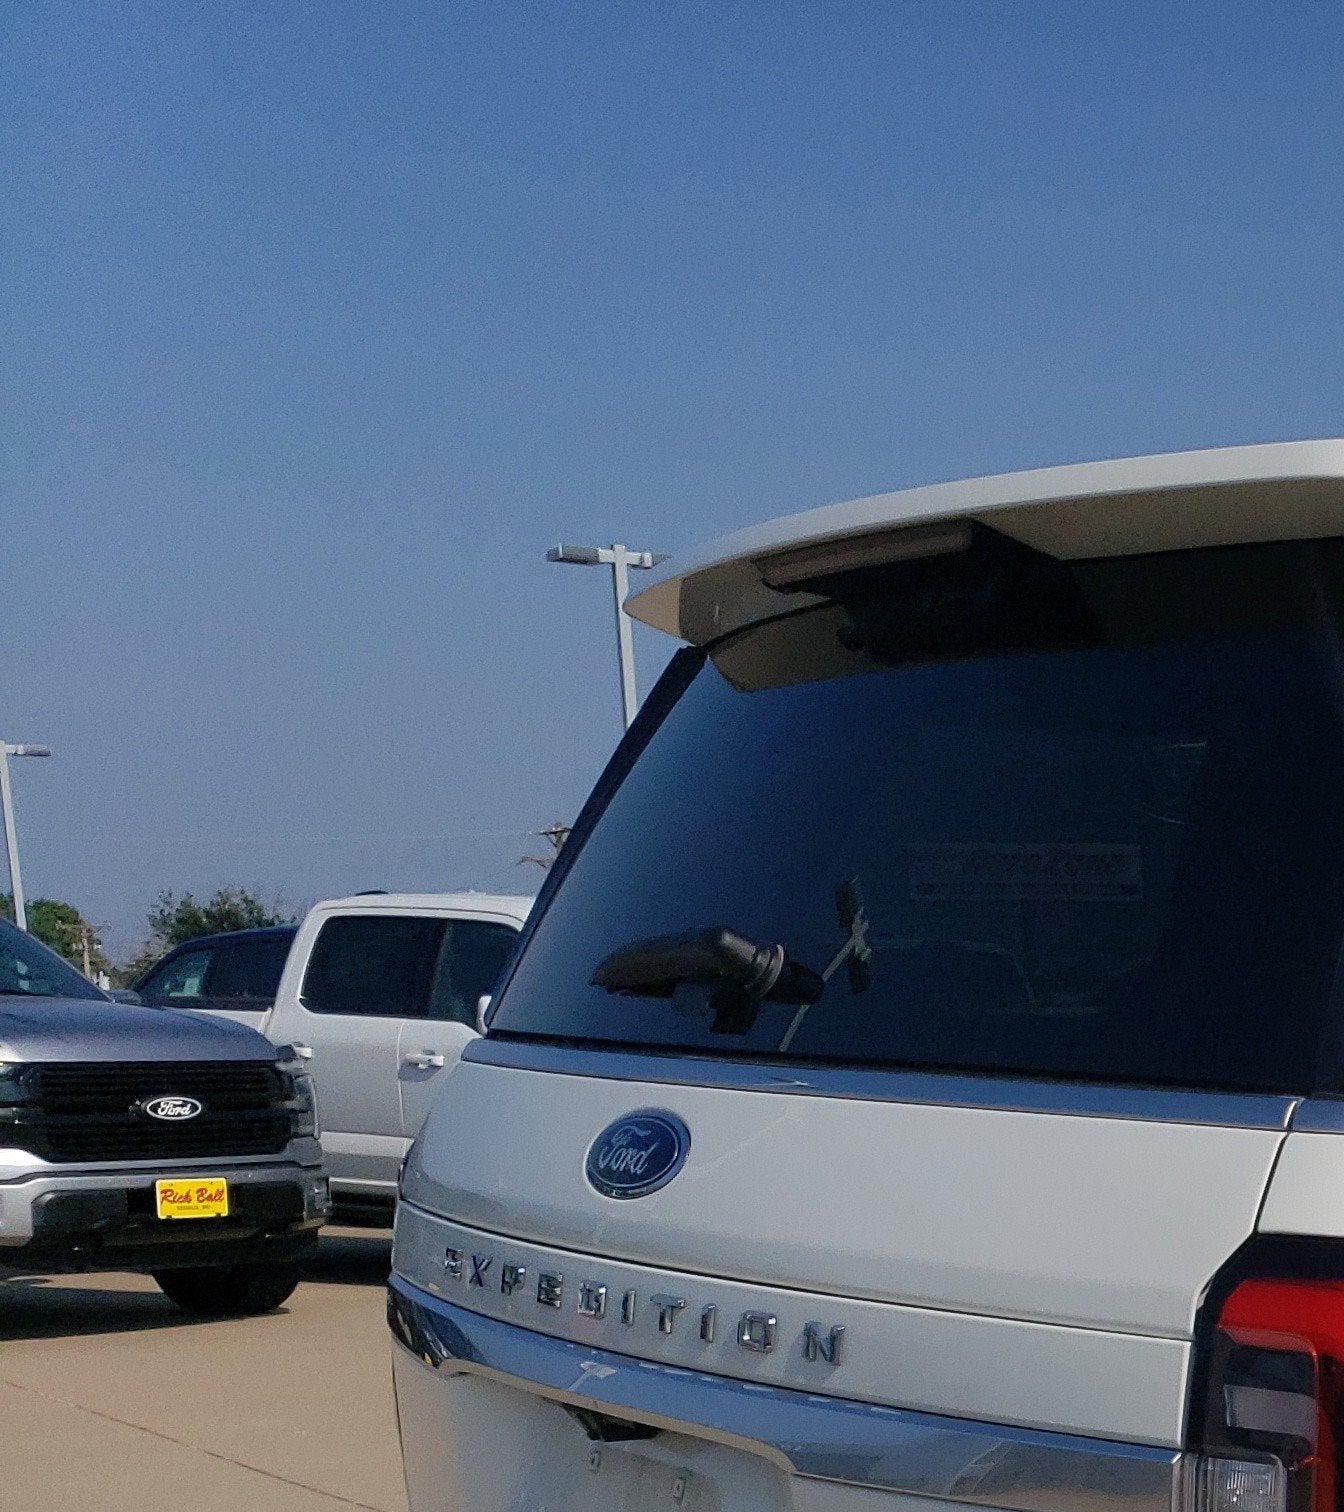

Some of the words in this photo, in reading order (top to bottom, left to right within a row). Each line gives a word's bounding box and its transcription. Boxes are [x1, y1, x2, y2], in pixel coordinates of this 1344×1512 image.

[157, 1100, 192, 1116] Ford
[598, 1124, 660, 1175] Ford
[160, 1187, 192, 1204] Rick
[195, 1187, 224, 1203] Ball
[443, 1247, 847, 1367] EXPEDITION
